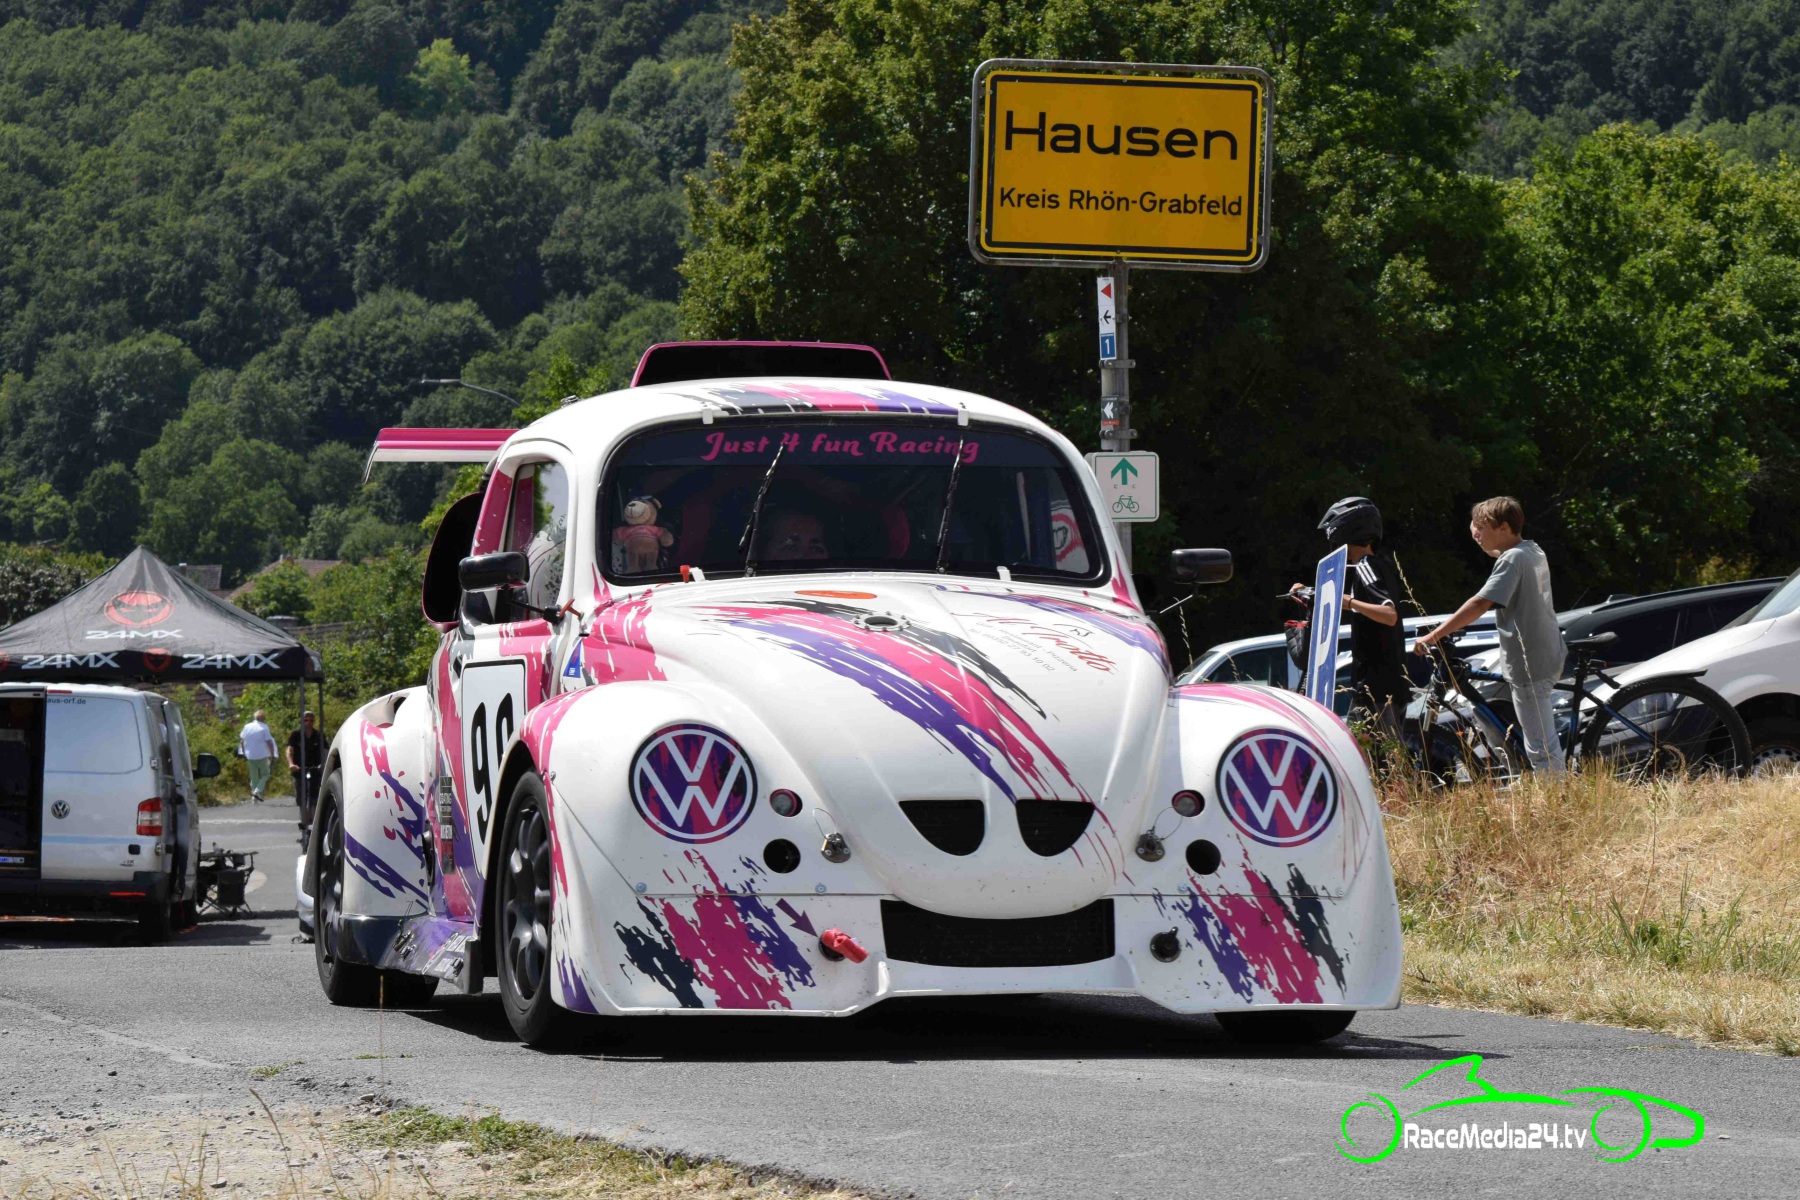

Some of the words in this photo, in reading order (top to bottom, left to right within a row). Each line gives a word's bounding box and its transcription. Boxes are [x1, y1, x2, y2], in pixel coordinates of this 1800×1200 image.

[1004, 110, 1238, 160] Hausen
[1000, 187, 1060, 209] Kreis
[1069, 189, 1242, 216] Rhön-Grabfeld
[1104, 338, 1111, 355] 1
[701, 432, 770, 461] Just
[781, 432, 800, 453] 4
[811, 433, 863, 457] fun
[869, 431, 979, 463] Racing
[85, 629, 183, 640] 24MX
[22, 652, 121, 670] 24MX
[182, 652, 281, 670] 24MX
